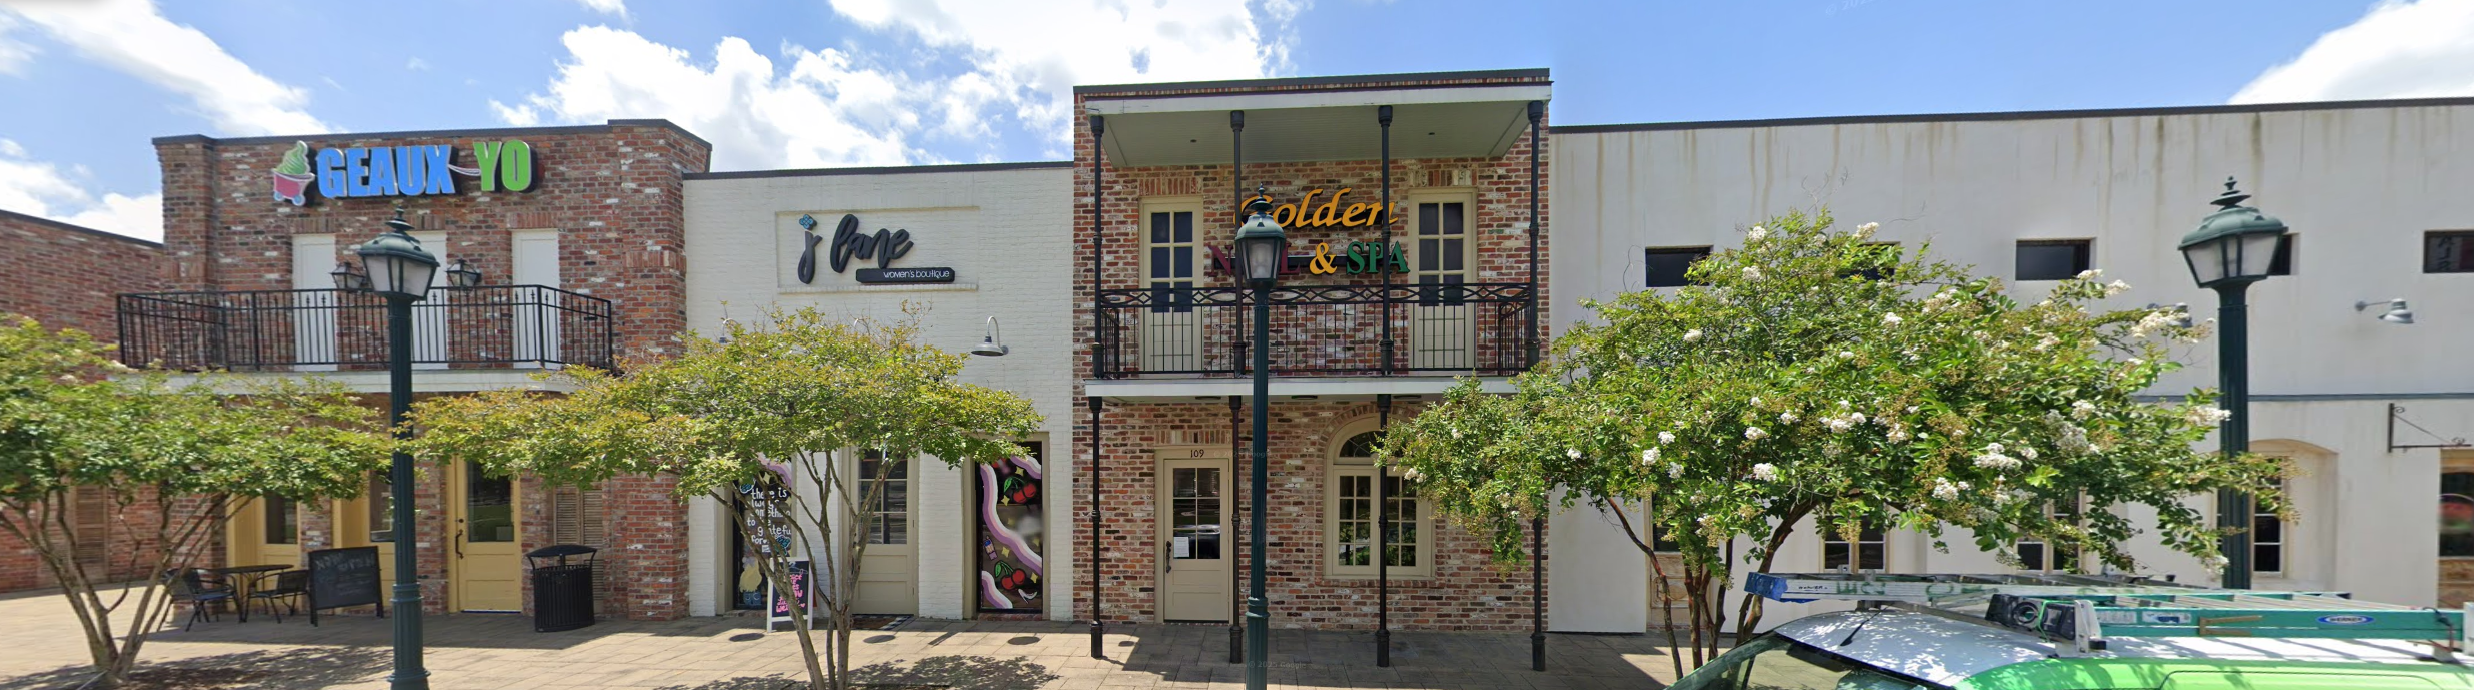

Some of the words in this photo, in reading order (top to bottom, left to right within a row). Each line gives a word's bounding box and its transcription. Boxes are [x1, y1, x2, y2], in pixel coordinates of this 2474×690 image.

[316, 145, 455, 199] GEAUX
[473, 140, 532, 192] YO
[829, 213, 914, 273] lane
[1207, 242, 1300, 277] NL
[1309, 242, 1338, 275] &
[1346, 240, 1411, 274] SPA
[883, 269, 915, 278] women's
[915, 268, 950, 279] boutique
[1190, 448, 1205, 458] 109
[750, 487, 775, 500] thee
[777, 487, 787, 498] is
[746, 517, 756, 527] to
[757, 524, 792, 537] gtefu
